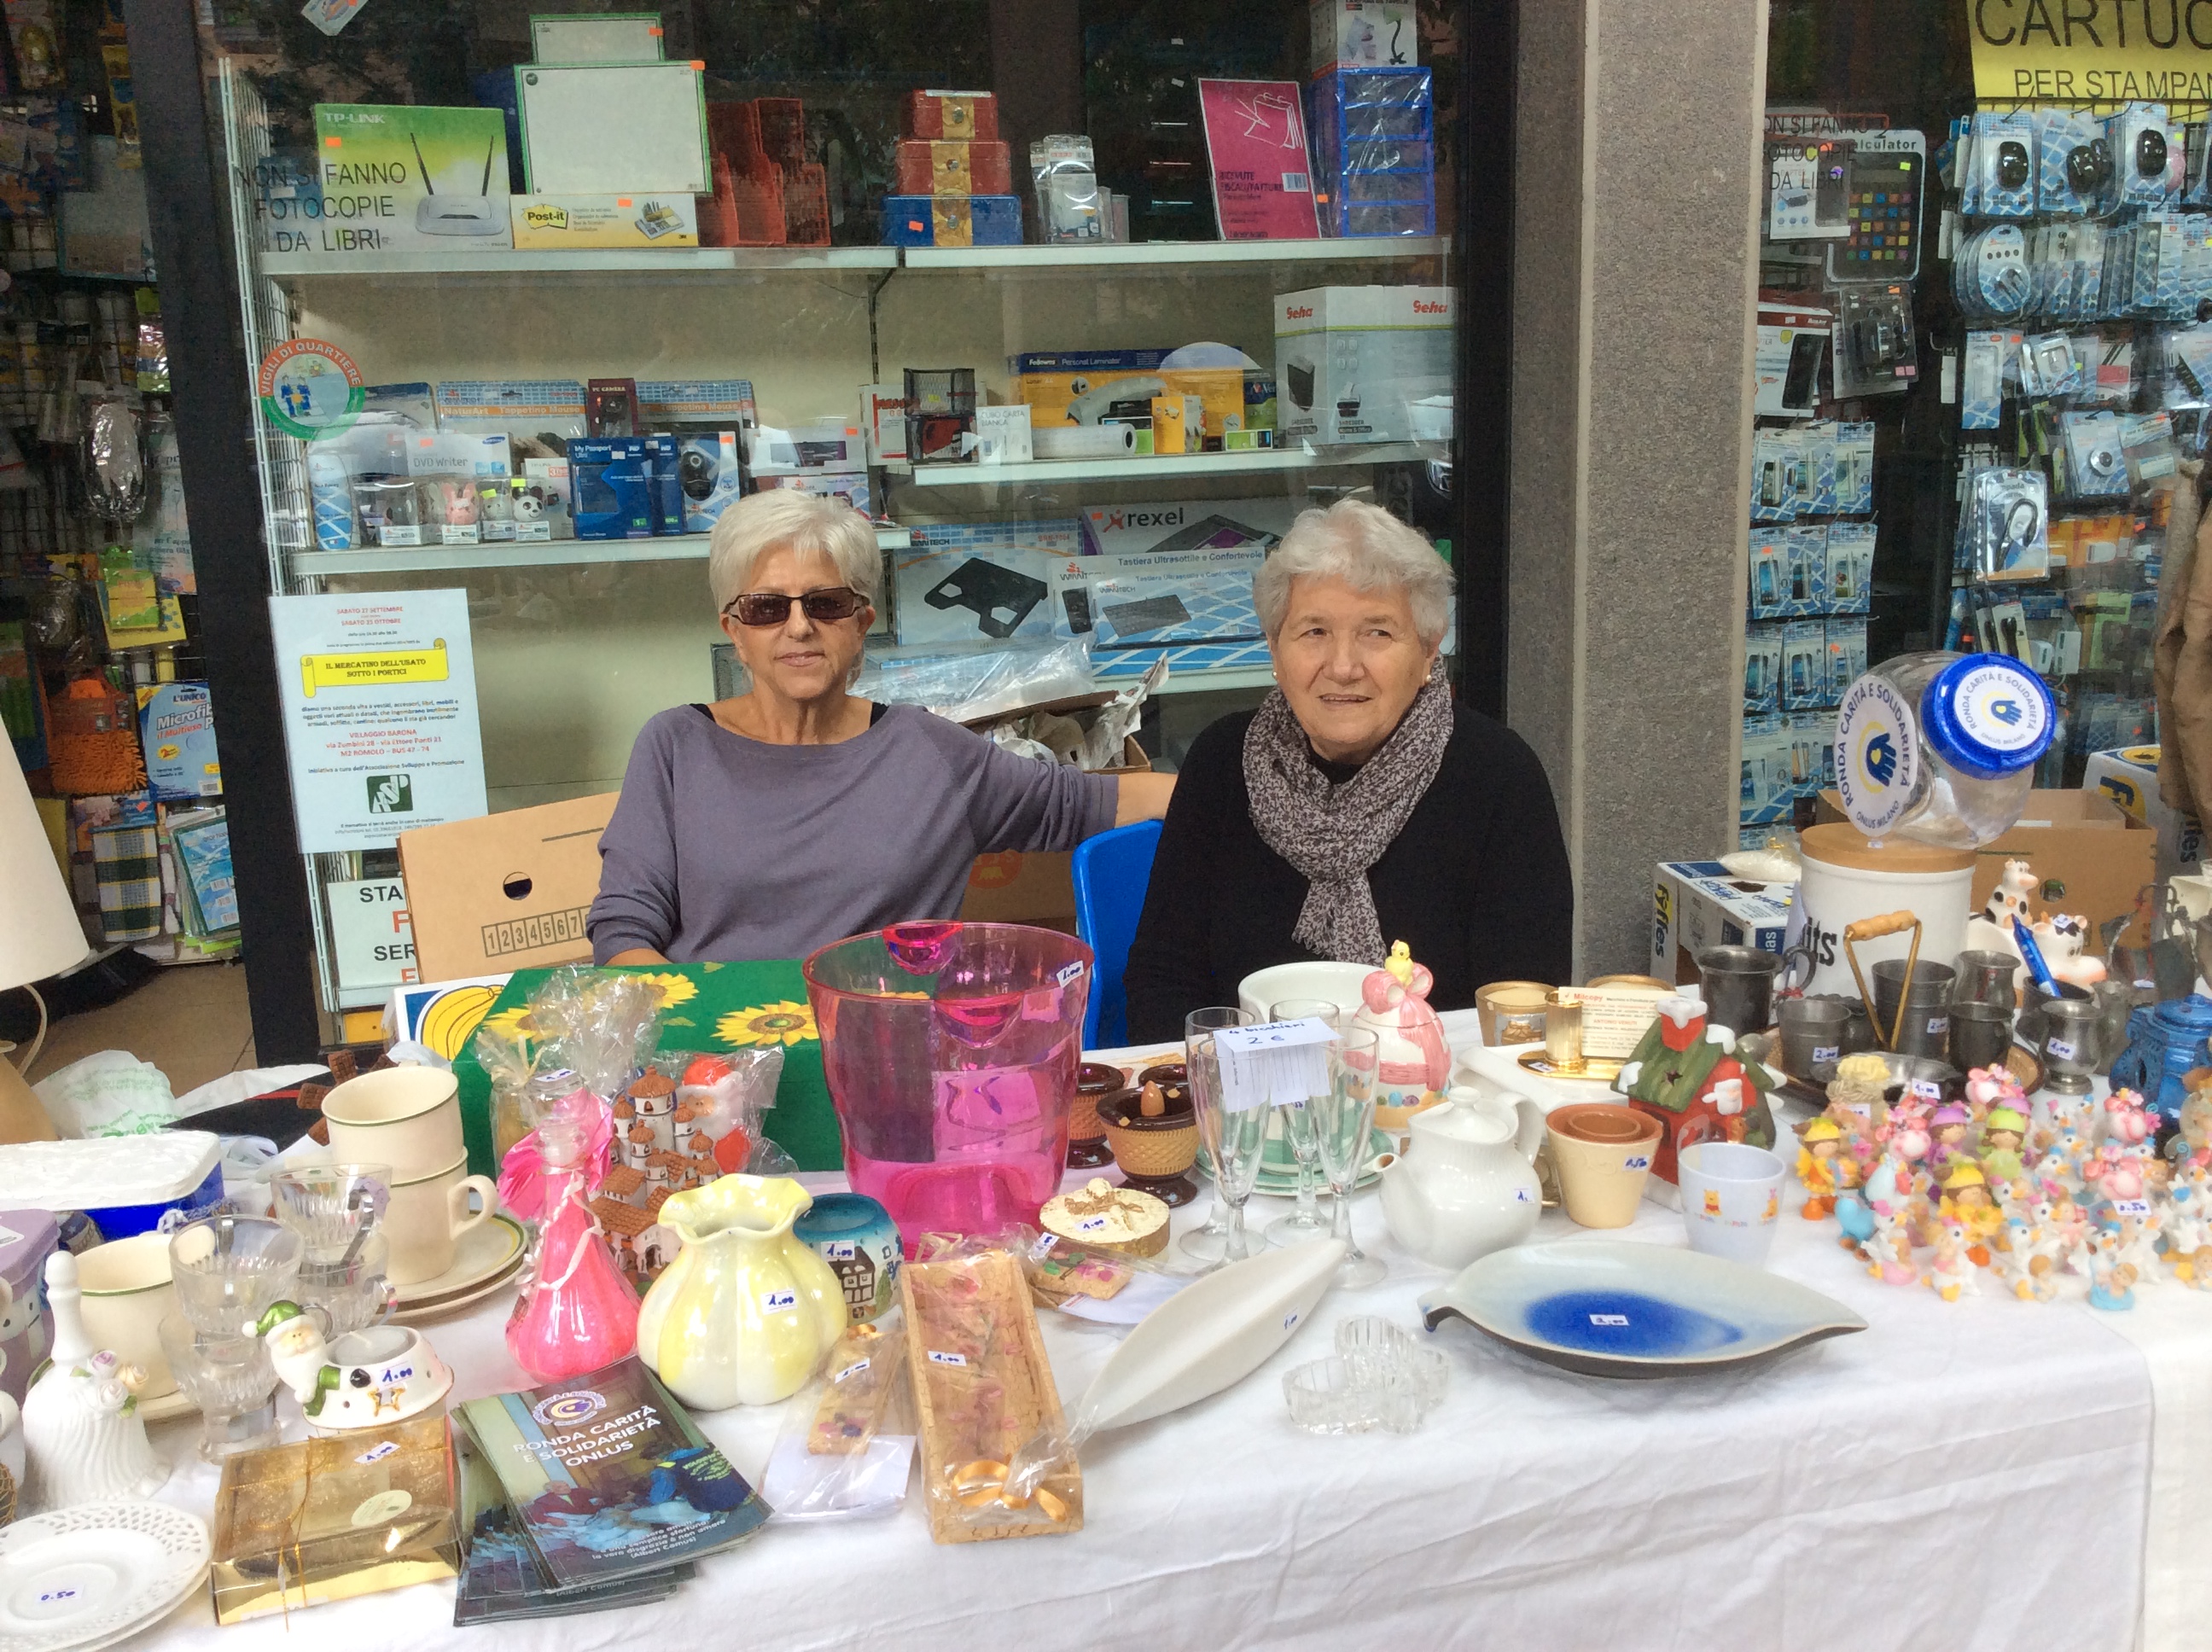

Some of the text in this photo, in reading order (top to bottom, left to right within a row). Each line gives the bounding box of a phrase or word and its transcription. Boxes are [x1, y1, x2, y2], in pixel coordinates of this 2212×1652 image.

[2014, 70, 2074, 97] PER
[324, 113, 385, 123] TP-LINK
[1854, 140, 1916, 149] alculator
[325, 162, 406, 185] FANNO
[1770, 172, 1792, 189] DA
[254, 195, 395, 220] FOTOCOPIE
[527, 212, 564, 221] Post-it
[276, 229, 381, 252] DA LIBRI
[1287, 306, 1313, 320] Geha
[1413, 300, 1447, 314] Geha
[261, 341, 361, 394] VIGILI DI QUARTIERE
[413, 457, 469, 468] DVD Writer
[1124, 507, 1185, 528] rexel
[1118, 557, 1152, 567] Tastiera
[1154, 555, 1200, 565] Ultrasottile
[1209, 550, 1263, 561] Confortevole
[380, 659, 426, 667] DELL'USATO
[1966, 672, 1995, 694] CARITÀ
[2005, 676, 2037, 730] SOLIDARIETÀ
[1963, 695, 1977, 730] RONDA
[165, 724, 202, 736] Multiuso
[1981, 731, 2026, 744] ONLUS MILANO
[1837, 683, 1912, 808] RONDA CARITÀ E SOLIDARIETÀ
[1856, 800, 1900, 829] ONLUS MILANO
[1574, 993, 1603, 1002] Milcopy
[827, 1244, 853, 1256] 1.00
[768, 1294, 795, 1306] 1.00
[381, 1368, 413, 1383] 1.00
[513, 1430, 585, 1454] RONDA
[590, 1405, 657, 1436] CARITÀ
[523, 1416, 661, 1463] E SOLIDARIETÀ
[565, 1440, 634, 1467] ONLUS
[697, 1519, 725, 1533] amare
[40, 1589, 77, 1602] 0.50
